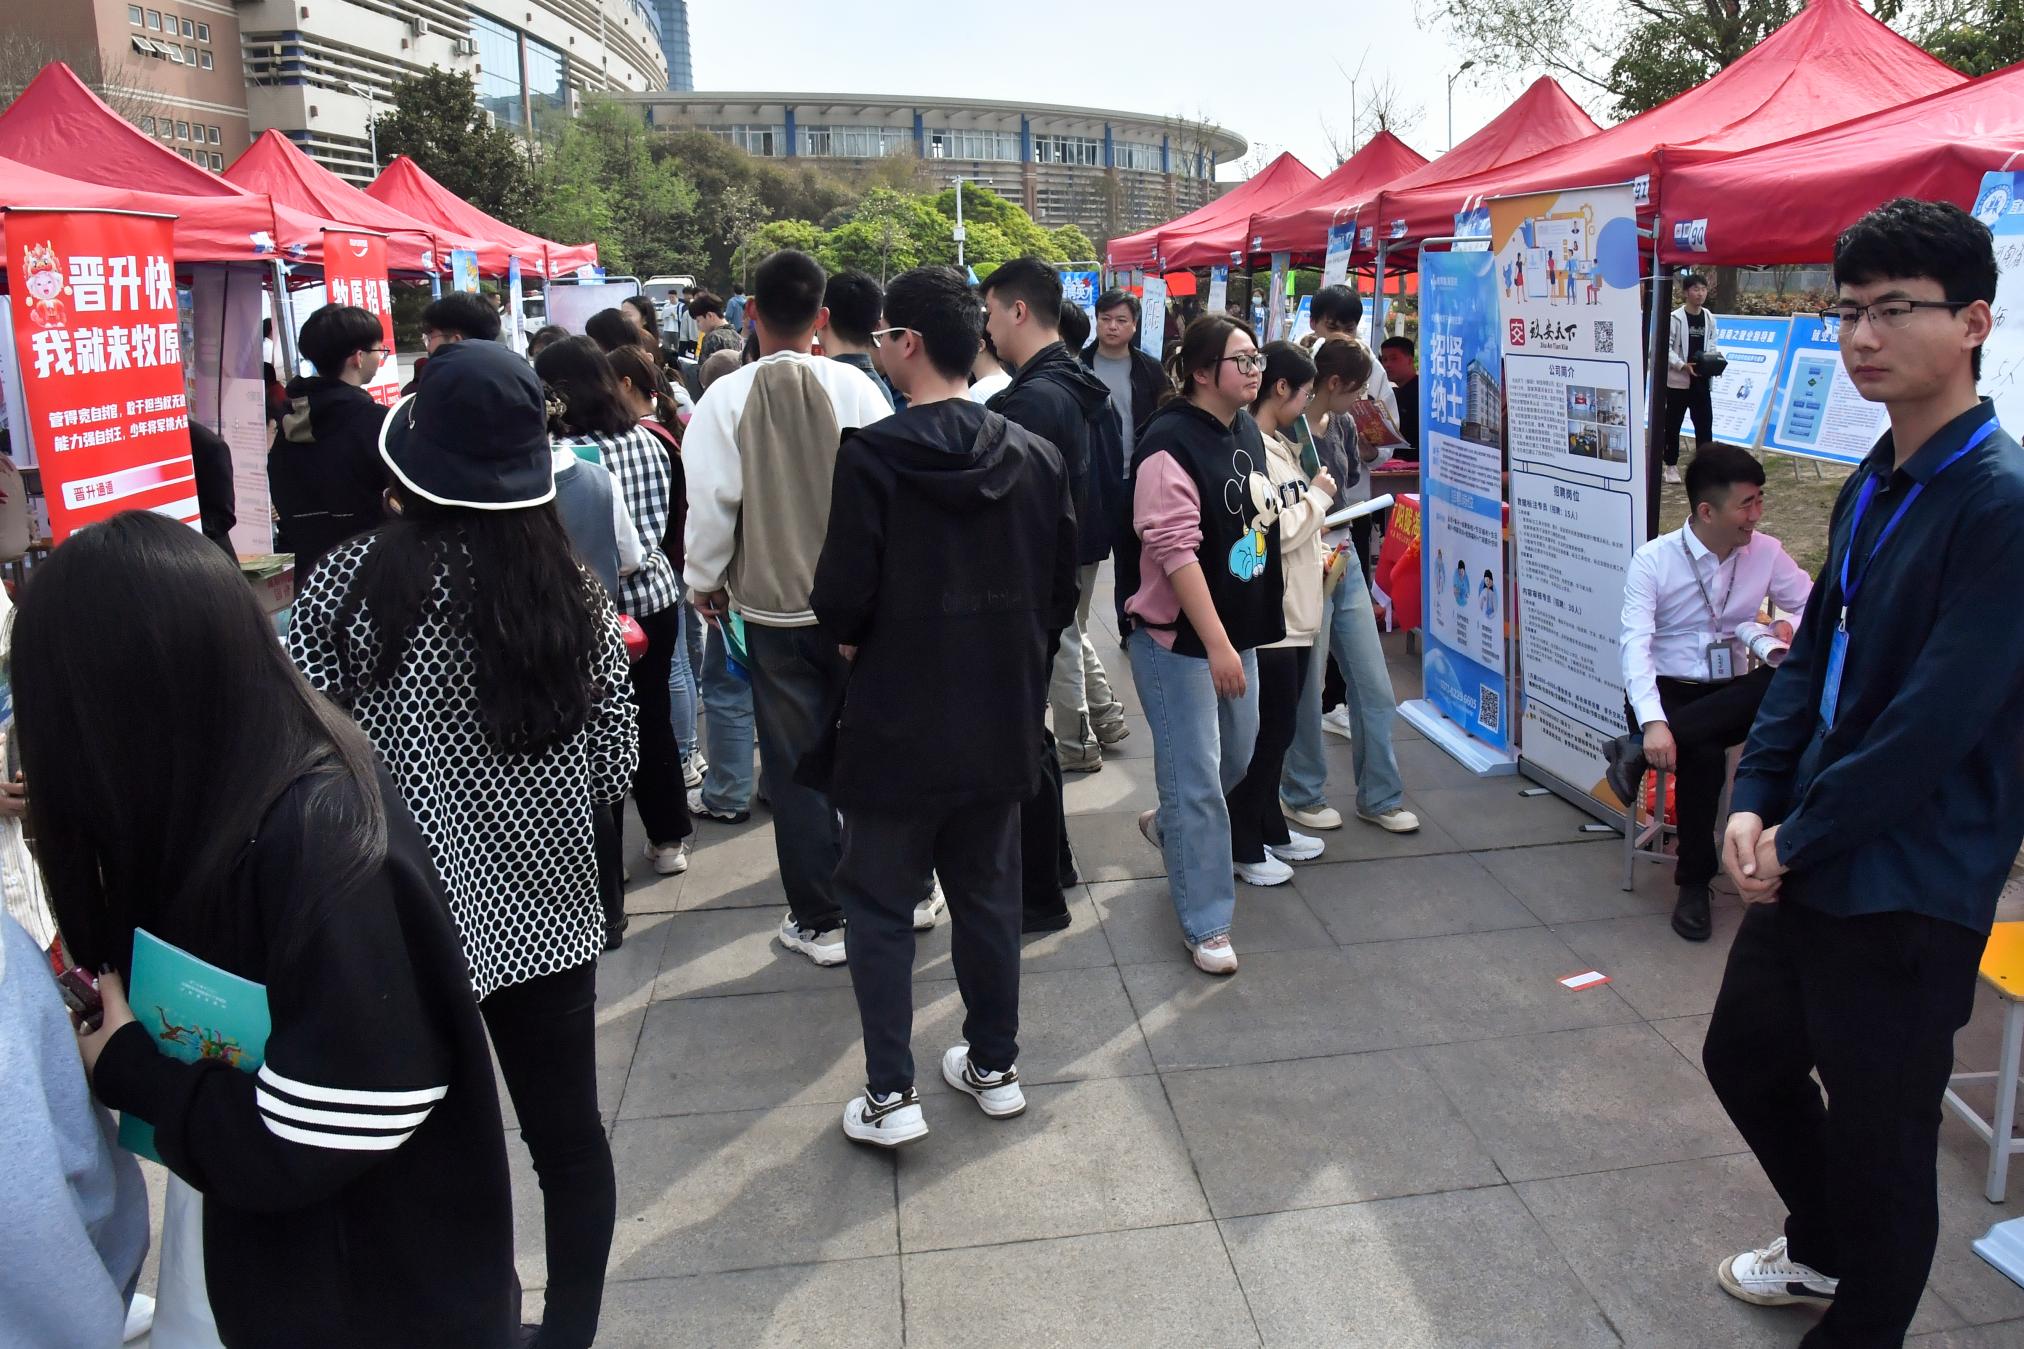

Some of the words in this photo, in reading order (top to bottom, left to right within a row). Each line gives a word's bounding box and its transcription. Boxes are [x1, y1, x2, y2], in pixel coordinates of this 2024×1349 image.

[1691, 226, 1704, 245] 90
[69, 255, 173, 312] 晋升快
[32, 323, 181, 378] 我就来牧原
[1431, 332, 1463, 380] 招贤
[1549, 364, 1575, 378] 公司简介
[1431, 379, 1463, 426] 纳士
[74, 480, 114, 502] 晋升通道
[1553, 485, 1580, 502] 招聘岗位
